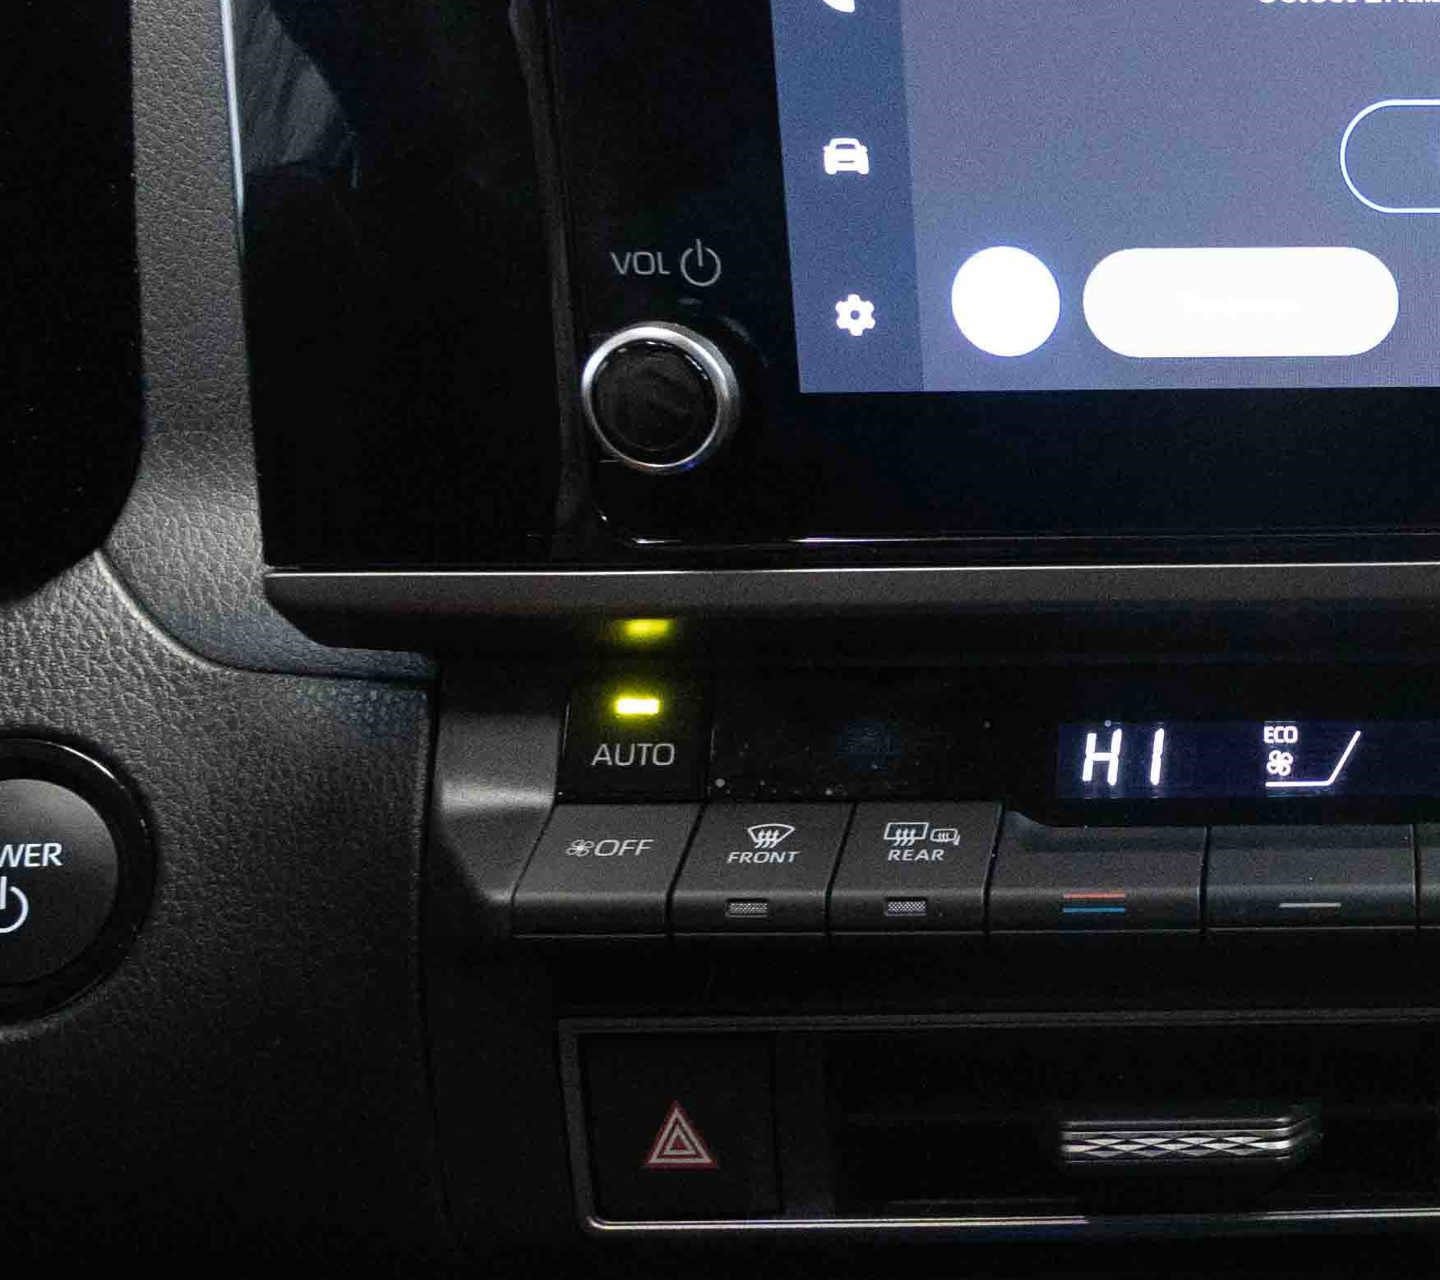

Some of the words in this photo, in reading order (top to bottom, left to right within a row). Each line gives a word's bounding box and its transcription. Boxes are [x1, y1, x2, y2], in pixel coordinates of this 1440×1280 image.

[611, 251, 671, 275] VOL
[1263, 725, 1299, 744] ECO
[591, 743, 676, 766] AUTO
[593, 839, 655, 857] OFF
[726, 850, 801, 864] FRONT
[887, 848, 946, 862] REAR
